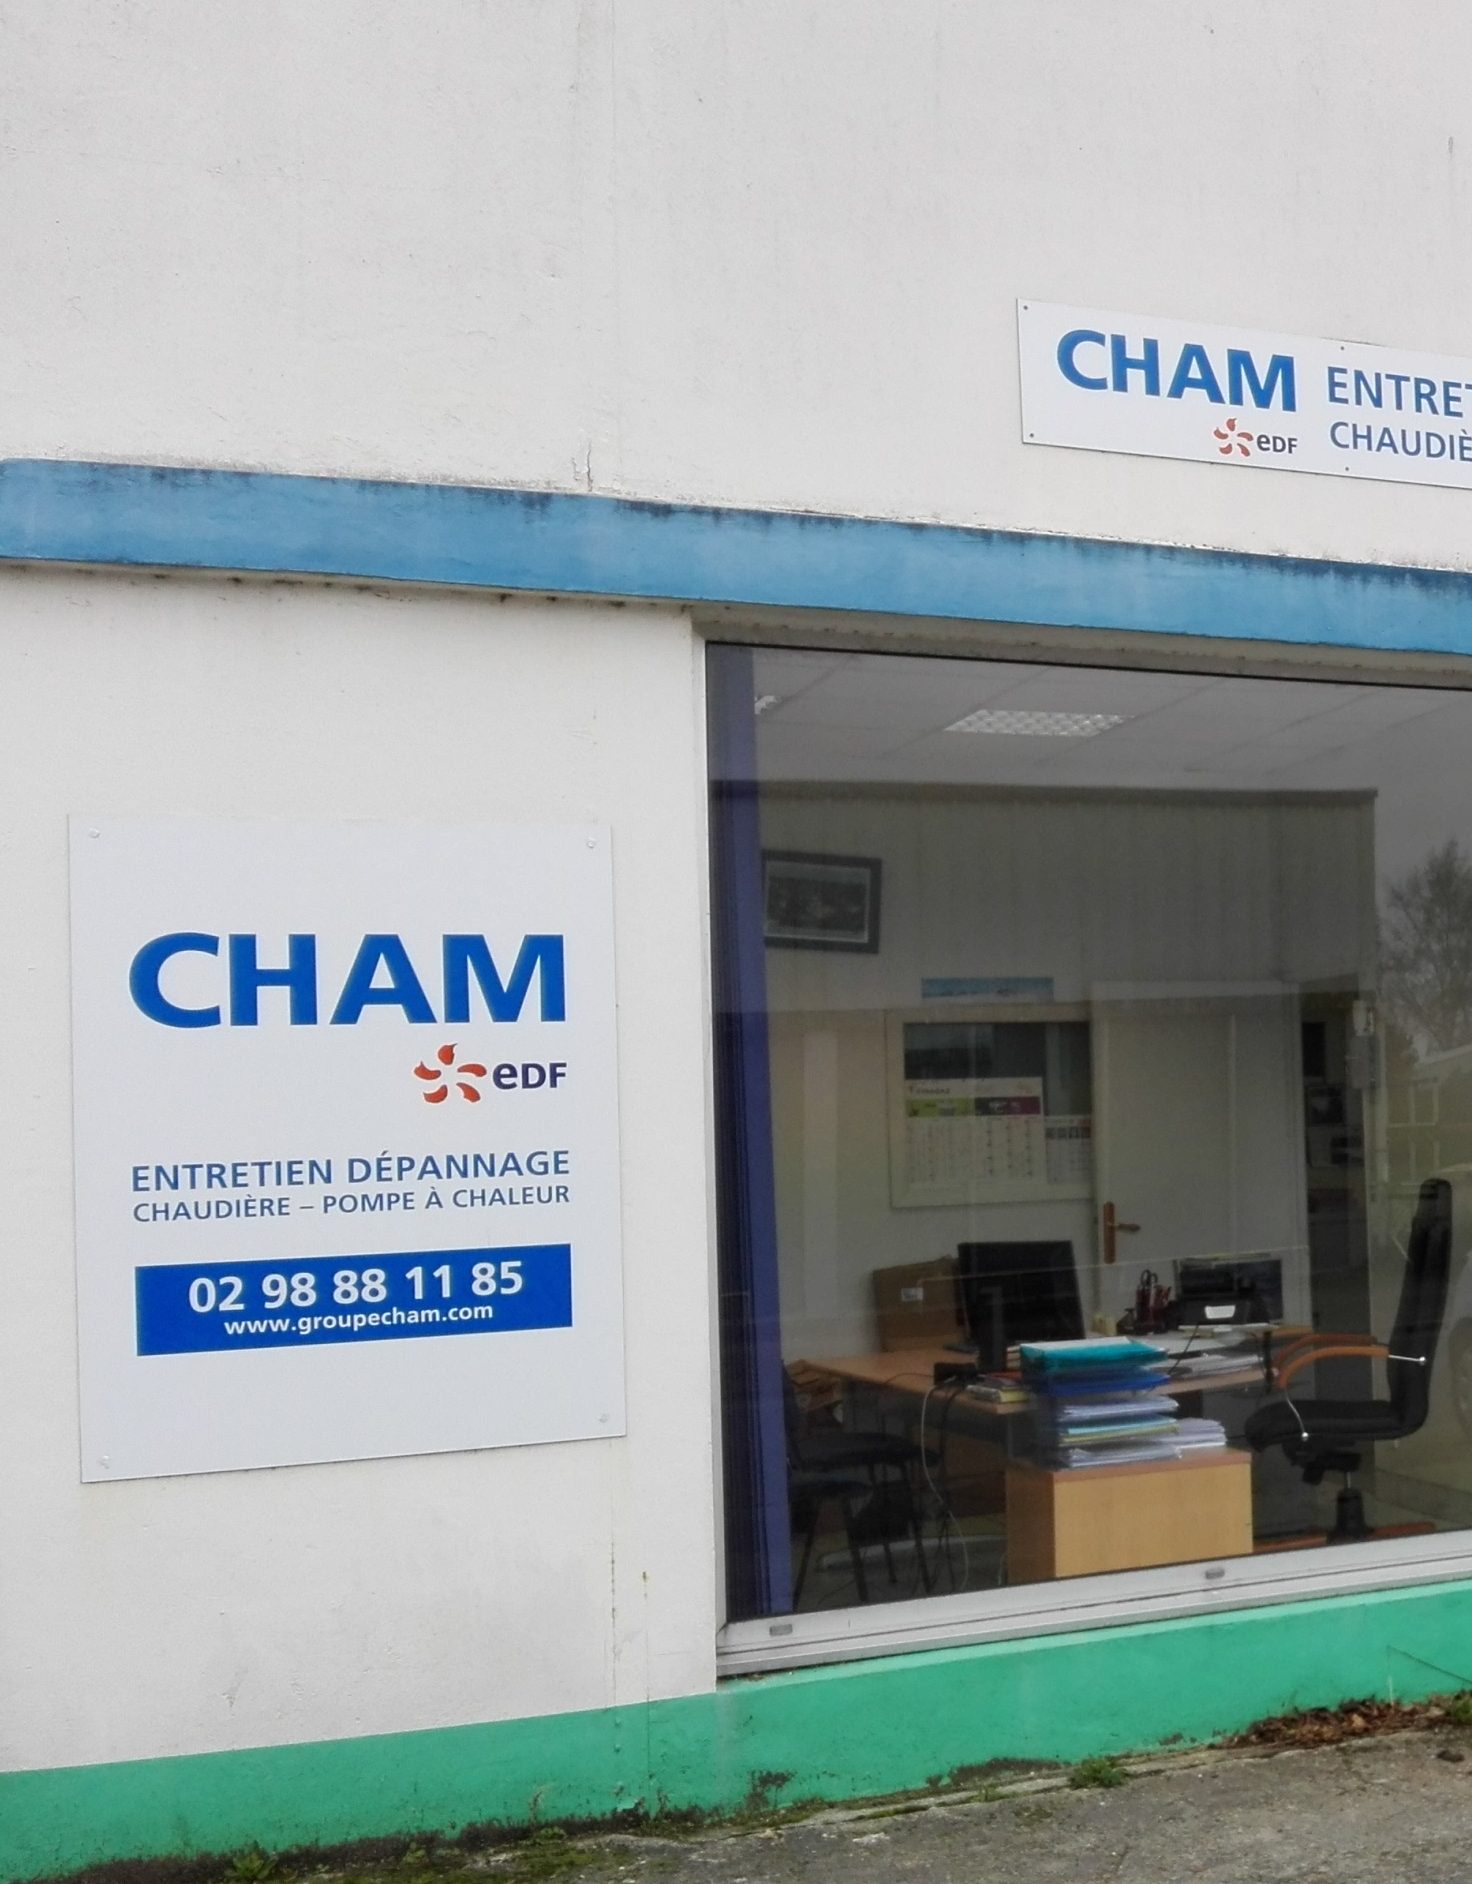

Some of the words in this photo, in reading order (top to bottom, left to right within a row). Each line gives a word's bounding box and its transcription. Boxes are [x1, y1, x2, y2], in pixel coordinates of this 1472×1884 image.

[1056, 329, 1298, 413] CHAM
[129, 931, 566, 1029] CHAM
[131, 1156, 333, 1192] ENTRETIEN
[347, 1149, 570, 1184] DÉPANNAGE
[133, 1193, 291, 1223] CHAUDIÈRE
[323, 1191, 415, 1215] POMPE
[425, 1182, 444, 1210] À
[452, 1184, 570, 1209] CHALEUR
[188, 1276, 245, 1314] 02
[262, 1272, 317, 1309] 98
[333, 1268, 387, 1305] 88
[405, 1265, 452, 1300] 11
[471, 1261, 523, 1295] 85
[223, 1301, 494, 1335] www.groupecham.com
